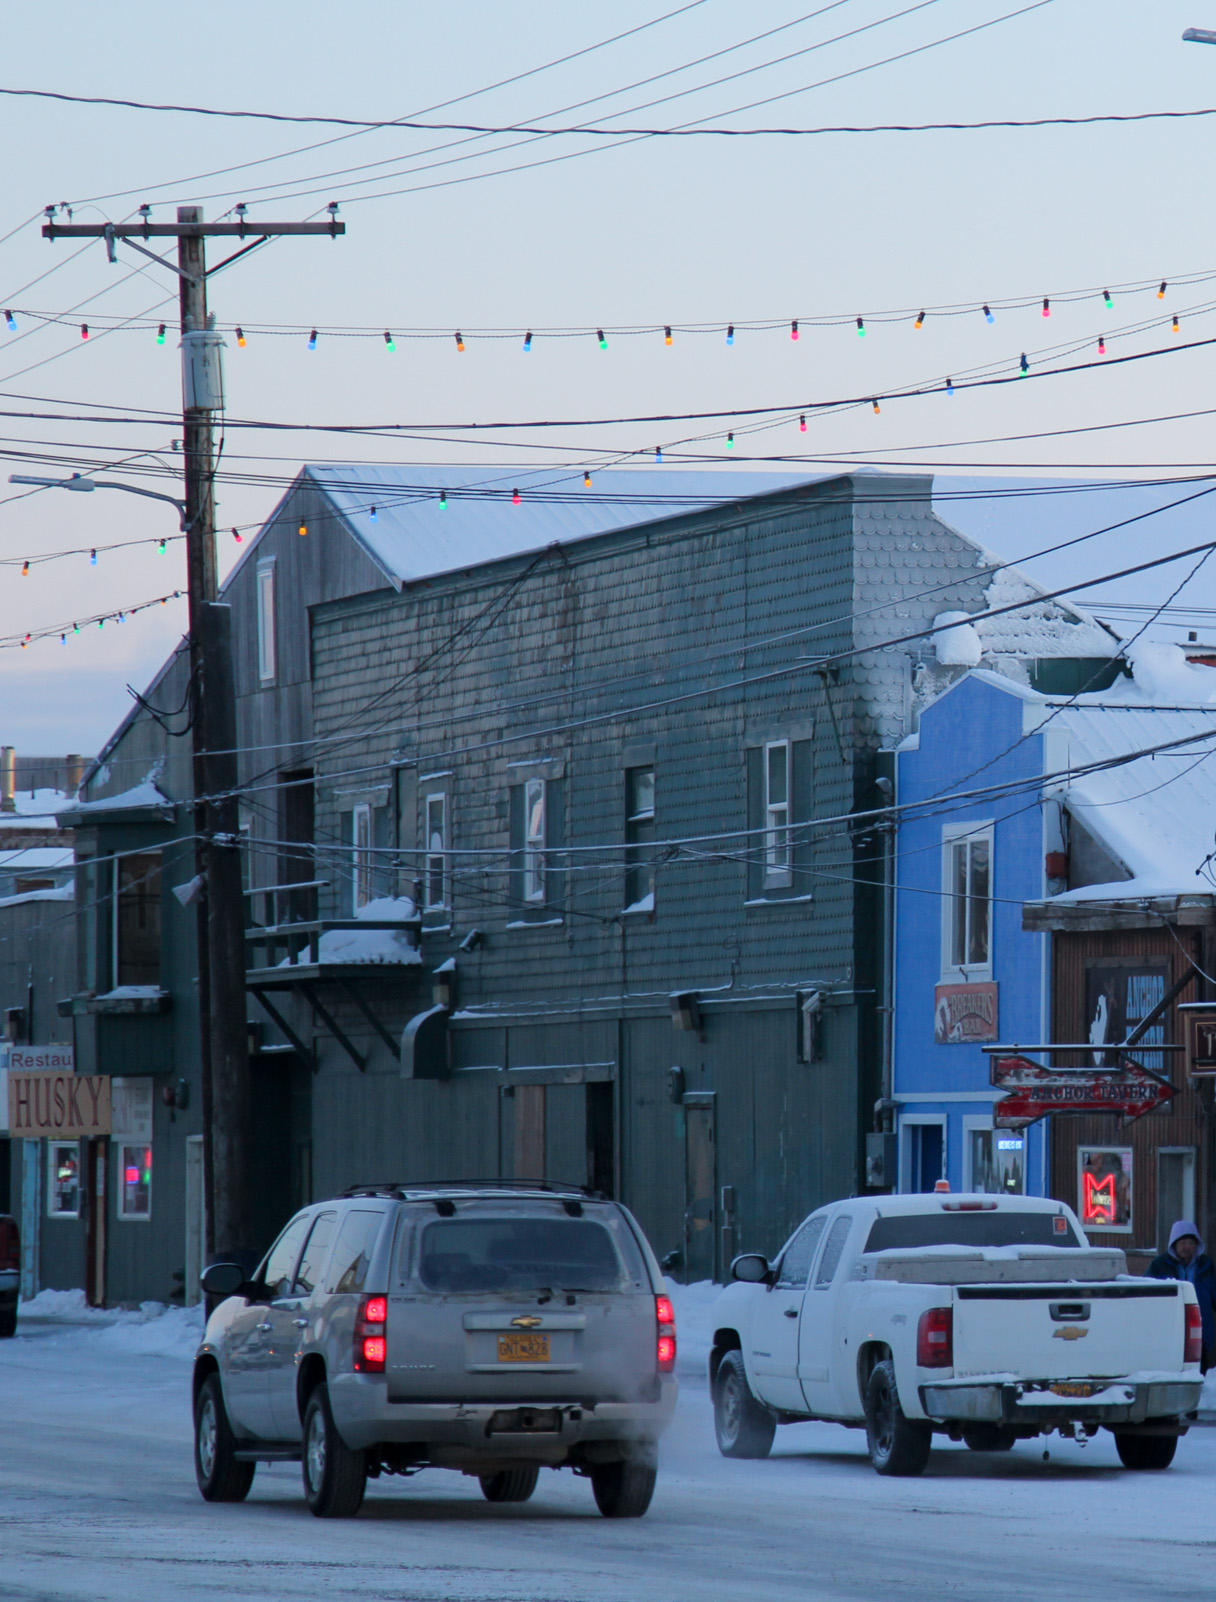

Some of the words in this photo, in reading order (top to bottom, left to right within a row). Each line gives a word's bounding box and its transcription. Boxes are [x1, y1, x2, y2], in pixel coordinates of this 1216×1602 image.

[949, 992, 993, 1026] BREAKERS
[14, 1077, 103, 1128] HUSKY
[1031, 1086, 1095, 1100] ANCHOR
[1100, 1086, 1158, 1099] TAVERN
[528, 1343, 548, 1355] 828
